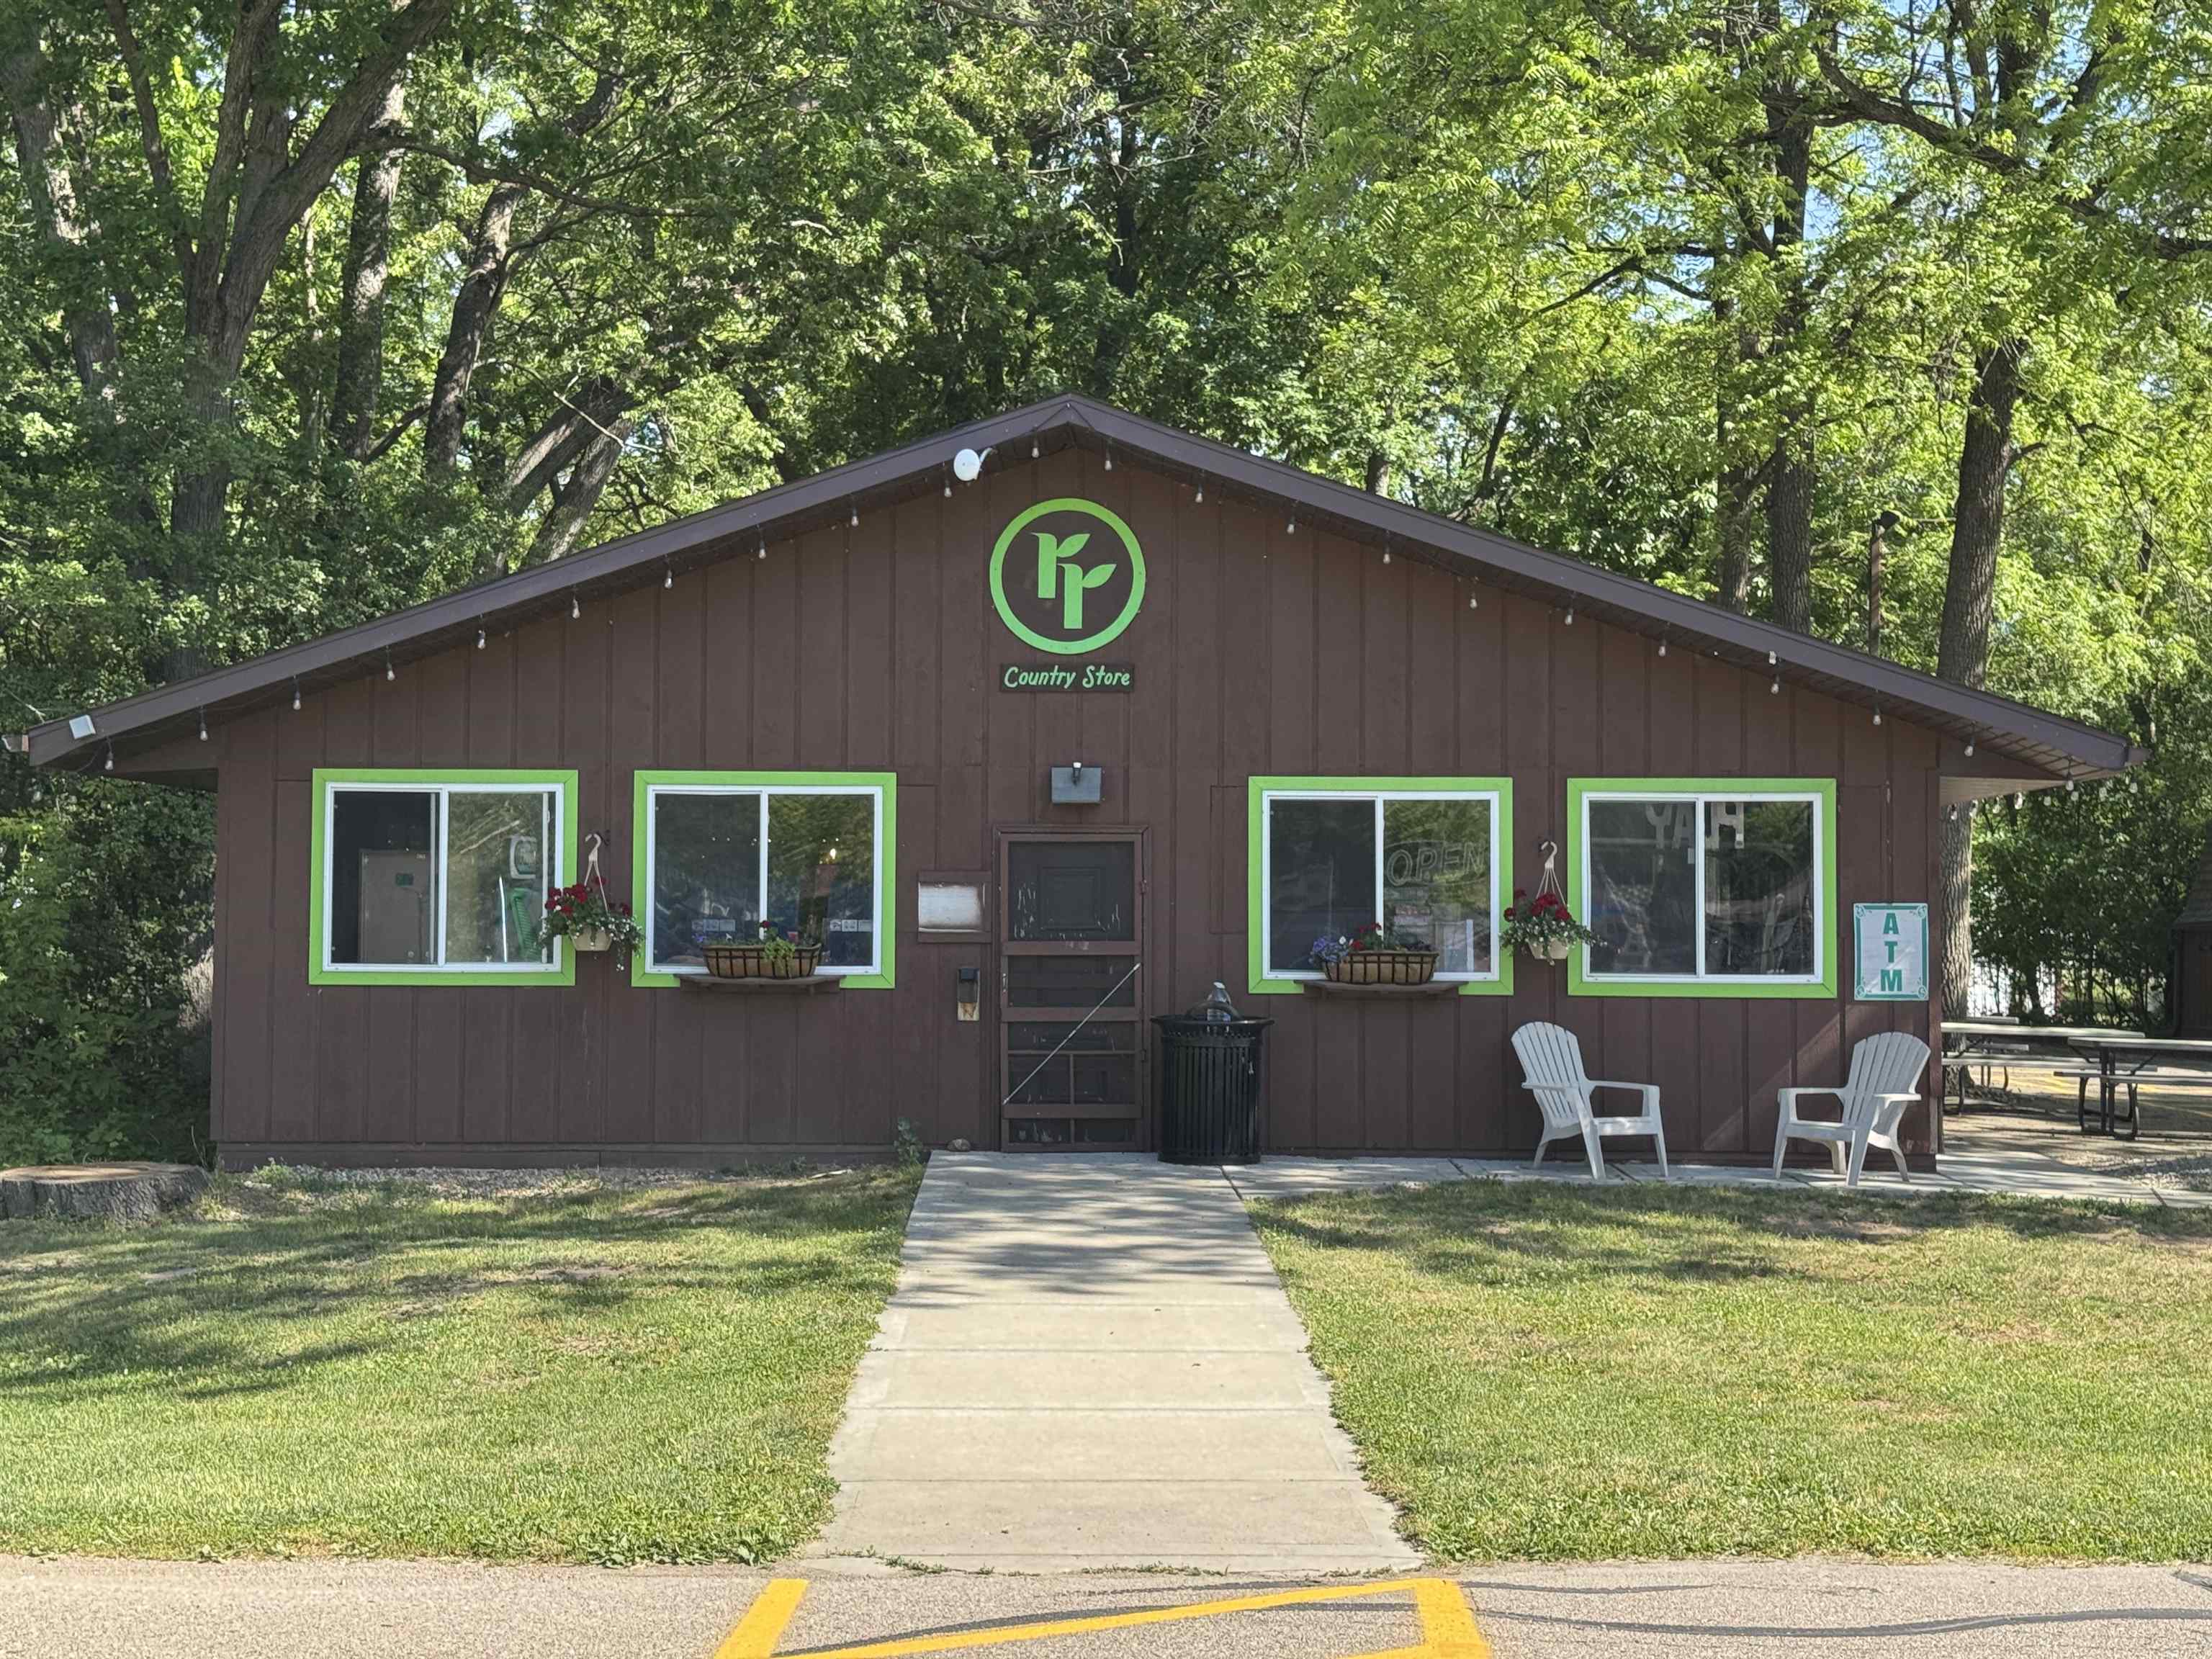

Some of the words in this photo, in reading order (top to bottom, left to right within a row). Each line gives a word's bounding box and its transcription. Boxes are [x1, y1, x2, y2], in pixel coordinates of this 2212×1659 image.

[1004, 665, 1076, 689] Country
[1082, 665, 1130, 688] Store
[1387, 841, 1485, 886] OPEN
[1880, 912, 1903, 992] ATM
